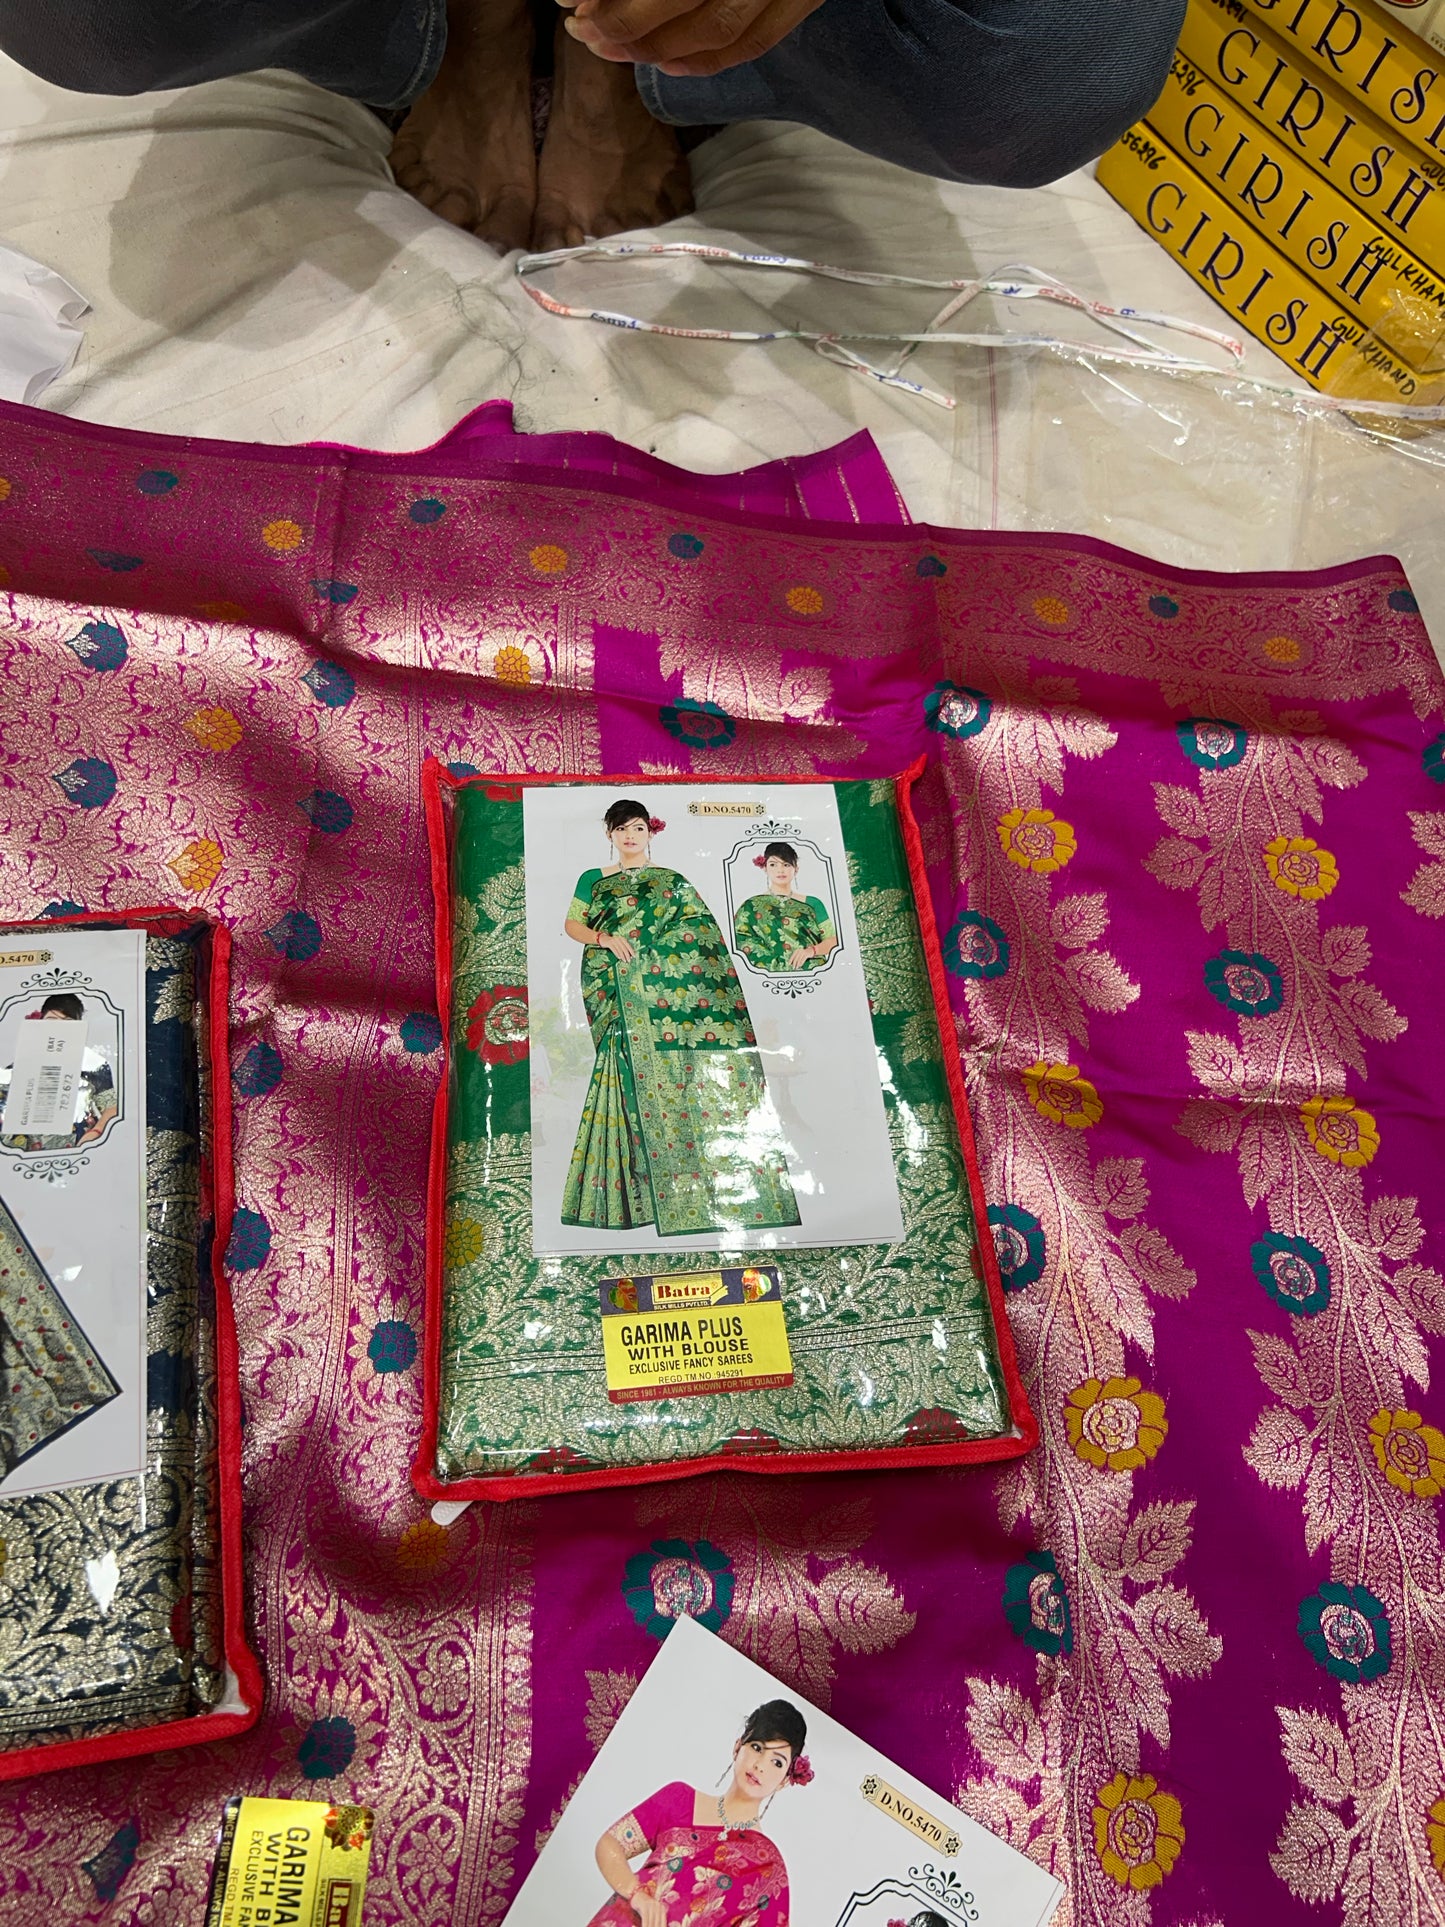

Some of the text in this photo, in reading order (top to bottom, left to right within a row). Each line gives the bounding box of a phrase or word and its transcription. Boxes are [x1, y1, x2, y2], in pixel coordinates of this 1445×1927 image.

[1217, 29, 1436, 233] GIRISH
[1184, 104, 1388, 305] GIRISH
[1146, 183, 1346, 380] GIRISH
[1366, 236, 1445, 319] GULKHAN
[703, 805, 752, 814] D.NO.5470
[657, 1285, 711, 1299] Batra
[620, 1316, 744, 1347] GARIMA PLUS
[628, 1338, 750, 1361] WITH BLOUSE
[629, 1353, 754, 1375] EXCLUSIVE FANCY SAREES
[616, 1391, 639, 1400] SINCE
[641, 1388, 657, 1397] 1981
[662, 1384, 692, 1395] ALWAYS
[693, 1380, 721, 1392] KNOWN
[722, 1379, 739, 1389] FOR
[740, 1377, 754, 1387] THE
[755, 1375, 785, 1386] QUALITY
[224, 1807, 239, 1838] SINCE
[880, 1792, 942, 1841] D.NO.5470
[241, 1830, 264, 1902] EXCLUSIVE
[259, 1832, 283, 1896] WITH
[273, 1827, 311, 1925] GARIMA
[211, 1871, 225, 1912] ALWAYS
